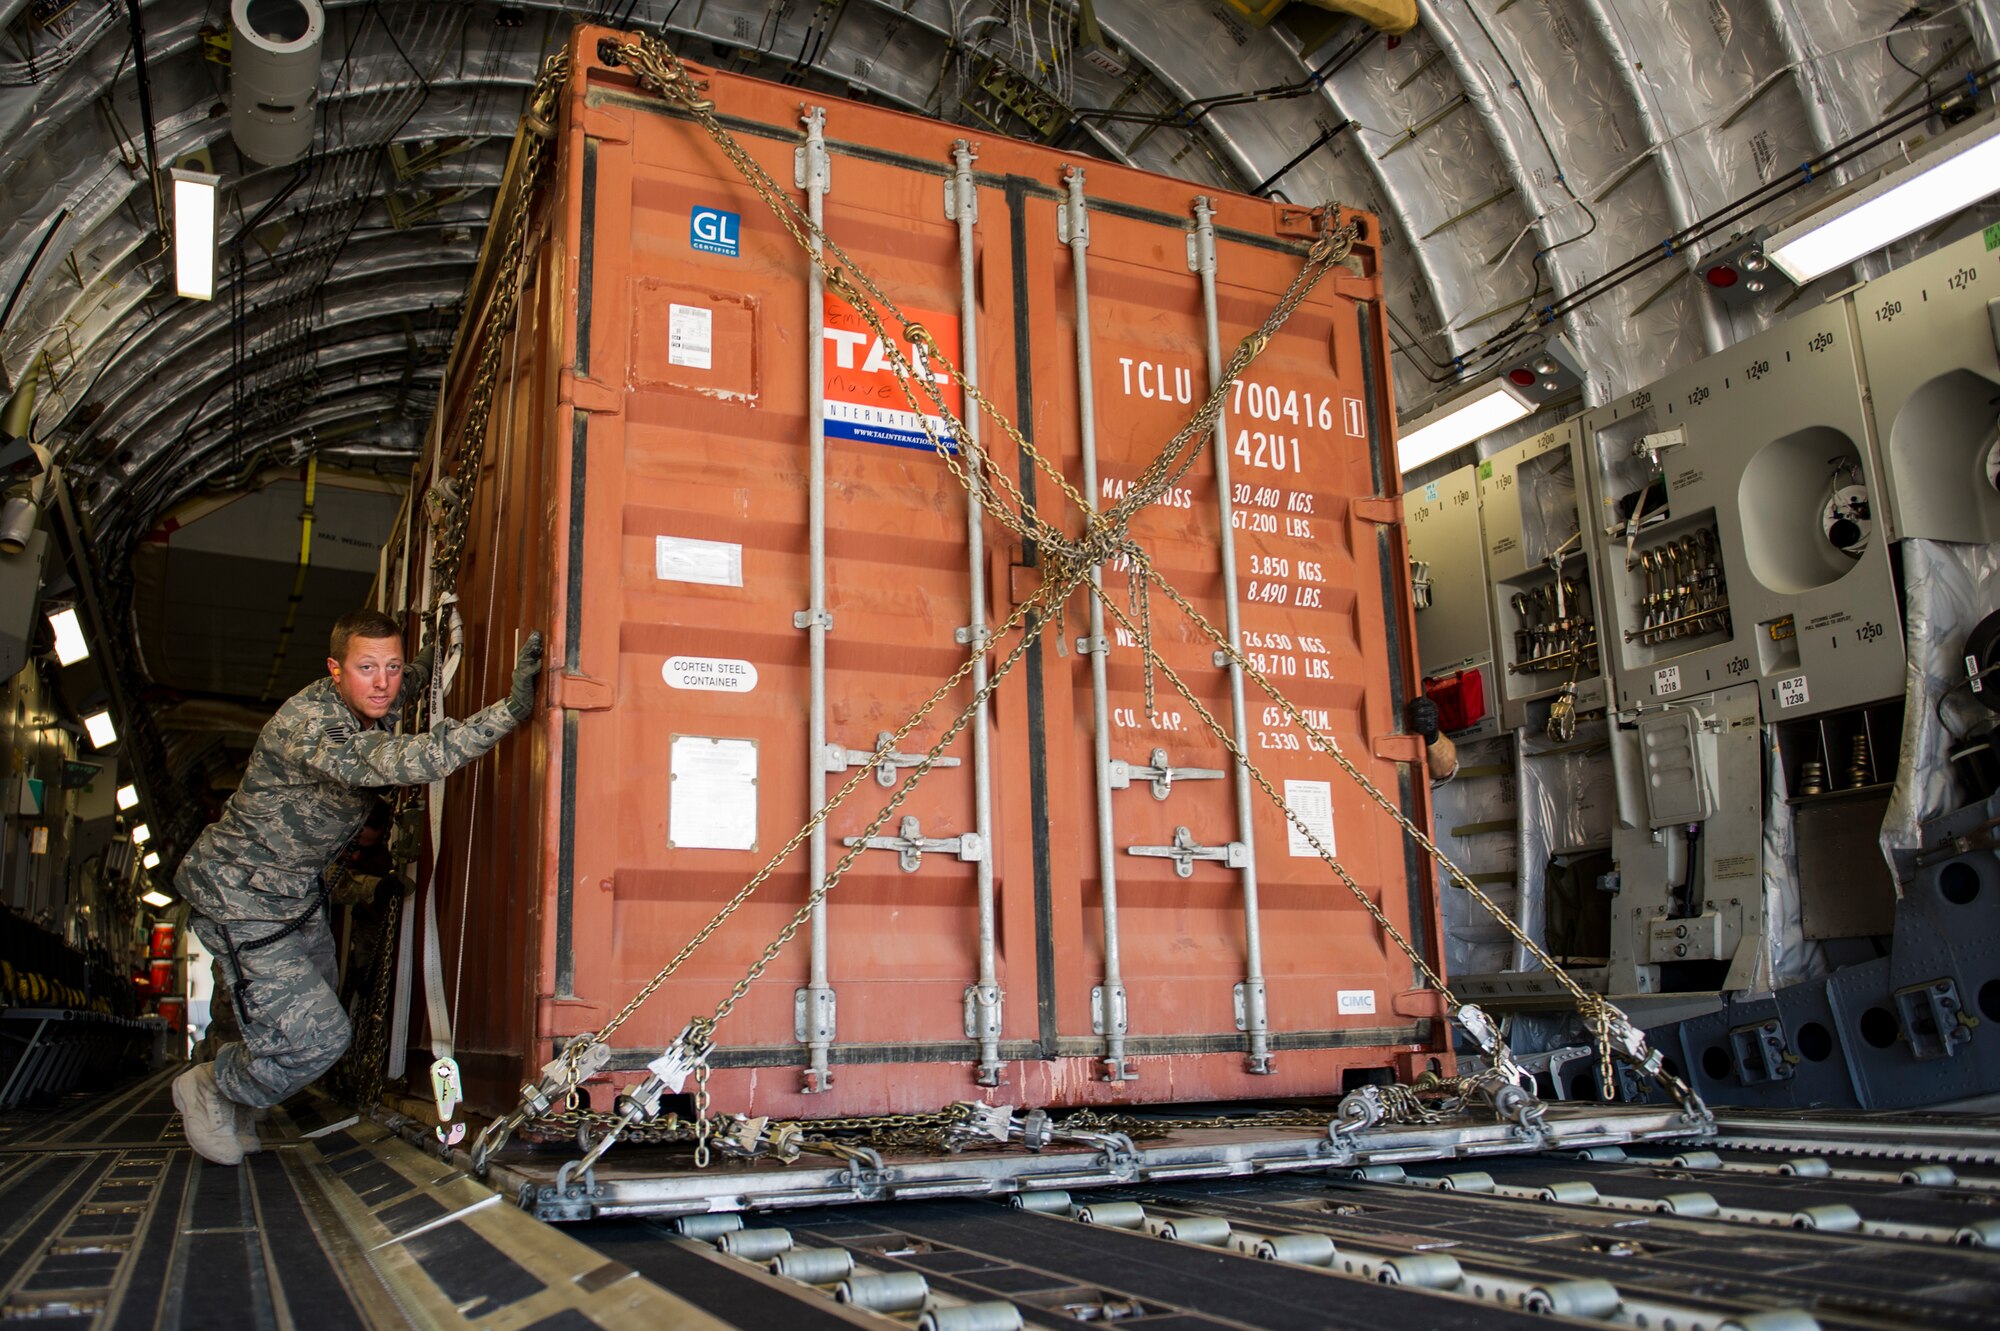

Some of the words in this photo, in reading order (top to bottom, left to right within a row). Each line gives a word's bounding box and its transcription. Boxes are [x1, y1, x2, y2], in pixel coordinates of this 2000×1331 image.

[693, 211, 736, 245] GL
[693, 243, 736, 256] CERTIFIED
[1948, 268, 1977, 290] 1270
[1875, 301, 1902, 322] 1260
[1808, 332, 1833, 353] 1250
[823, 327, 949, 385] TAL
[1746, 360, 1769, 380] 1240
[1119, 357, 1192, 404] TCLU
[1231, 379, 1332, 431] 700416
[1349, 402, 1359, 435] 1
[1631, 391, 1651, 409] 1220
[1688, 387, 1710, 405] 1230
[830, 404, 952, 432] NTERNATINA
[1235, 429, 1301, 473] 42U1
[1287, 491, 1314, 514] KGS.
[1286, 517, 1315, 539] LBS.
[1298, 560, 1327, 583] KGS.
[1295, 586, 1323, 609] LBS.
[1115, 627, 1144, 648] NE
[1856, 623, 1883, 641] 1250
[1297, 636, 1331, 655] KGS.
[673, 661, 713, 673] CORTEN
[718, 663, 747, 675] STEEL
[1305, 658, 1334, 680] LBS.
[1658, 670, 1667, 680] AD
[1668, 667, 1676, 677] 21
[1726, 658, 1750, 675] 1230
[683, 675, 738, 688] CONTAINER
[1660, 681, 1677, 694] 1218
[1782, 680, 1792, 691] AD
[1793, 677, 1803, 688] 22
[1785, 692, 1804, 706] 1238
[1114, 708, 1141, 729] CU.
[1150, 710, 1188, 732] CAP.
[1262, 706, 1292, 727] 65.9
[1340, 995, 1372, 1007] CIMC
